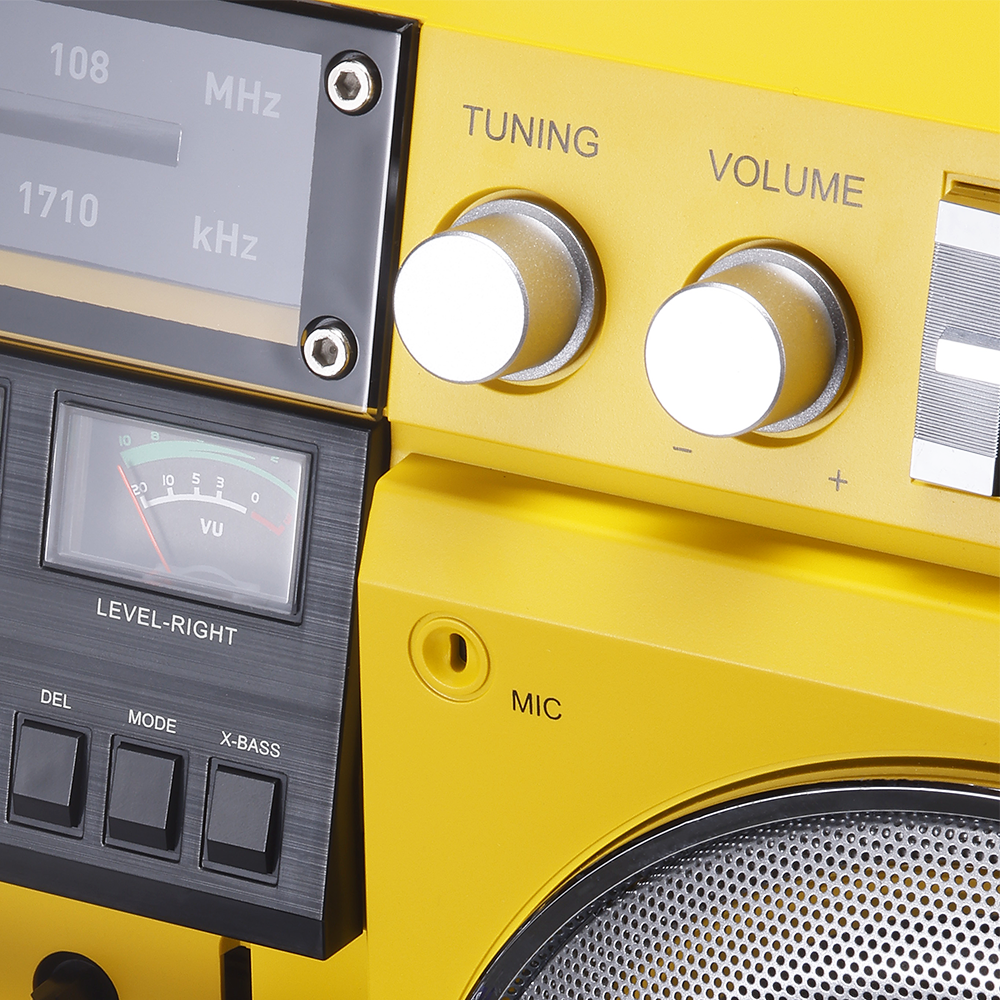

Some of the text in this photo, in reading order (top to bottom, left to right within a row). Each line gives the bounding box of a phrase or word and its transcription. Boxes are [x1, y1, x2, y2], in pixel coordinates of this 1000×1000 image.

[50, 42, 110, 84] 108
[205, 71, 282, 119] MHz
[462, 104, 600, 159] TUNING
[708, 148, 865, 209] VOLUME
[19, 181, 99, 228] 1710
[192, 215, 258, 261] kHz
[119, 434, 132, 447] 10
[132, 481, 148, 496] 20
[162, 474, 175, 486] 10
[191, 472, 201, 485] 5
[216, 476, 225, 488] 3
[251, 492, 260, 504] 0
[200, 517, 224, 538] VU
[96, 597, 238, 646] LEVEL-RIGHT
[40, 688, 72, 711] DEL
[511, 689, 562, 721] MIC
[128, 708, 178, 734] MODE
[219, 730, 281, 759] X-BASS
